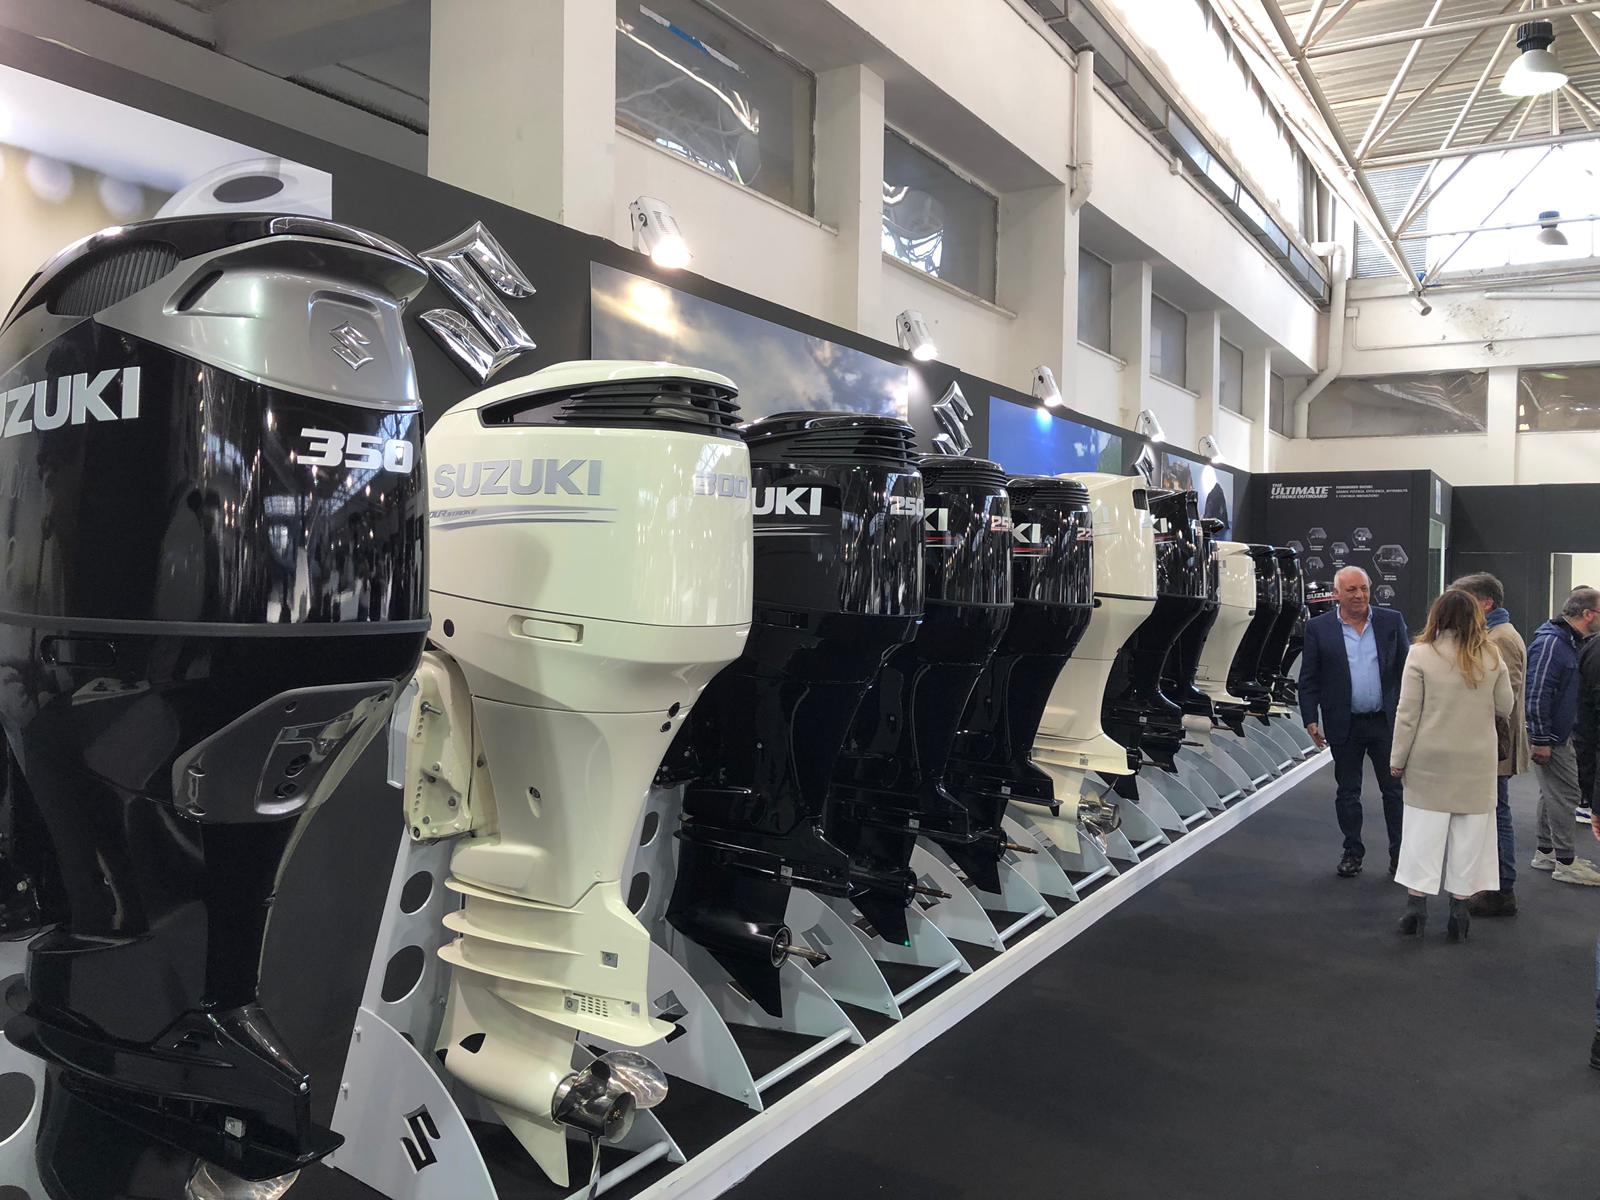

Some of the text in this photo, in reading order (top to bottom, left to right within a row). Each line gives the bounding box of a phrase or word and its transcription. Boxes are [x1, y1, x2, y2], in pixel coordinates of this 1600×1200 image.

[0, 366, 141, 438] ZUKI
[297, 427, 414, 473] 350
[432, 458, 604, 499] SUZUKI
[695, 471, 748, 499] 300
[1271, 486, 1329, 496] ULTIMATE
[752, 486, 823, 516] UKI
[890, 495, 924, 516] 250
